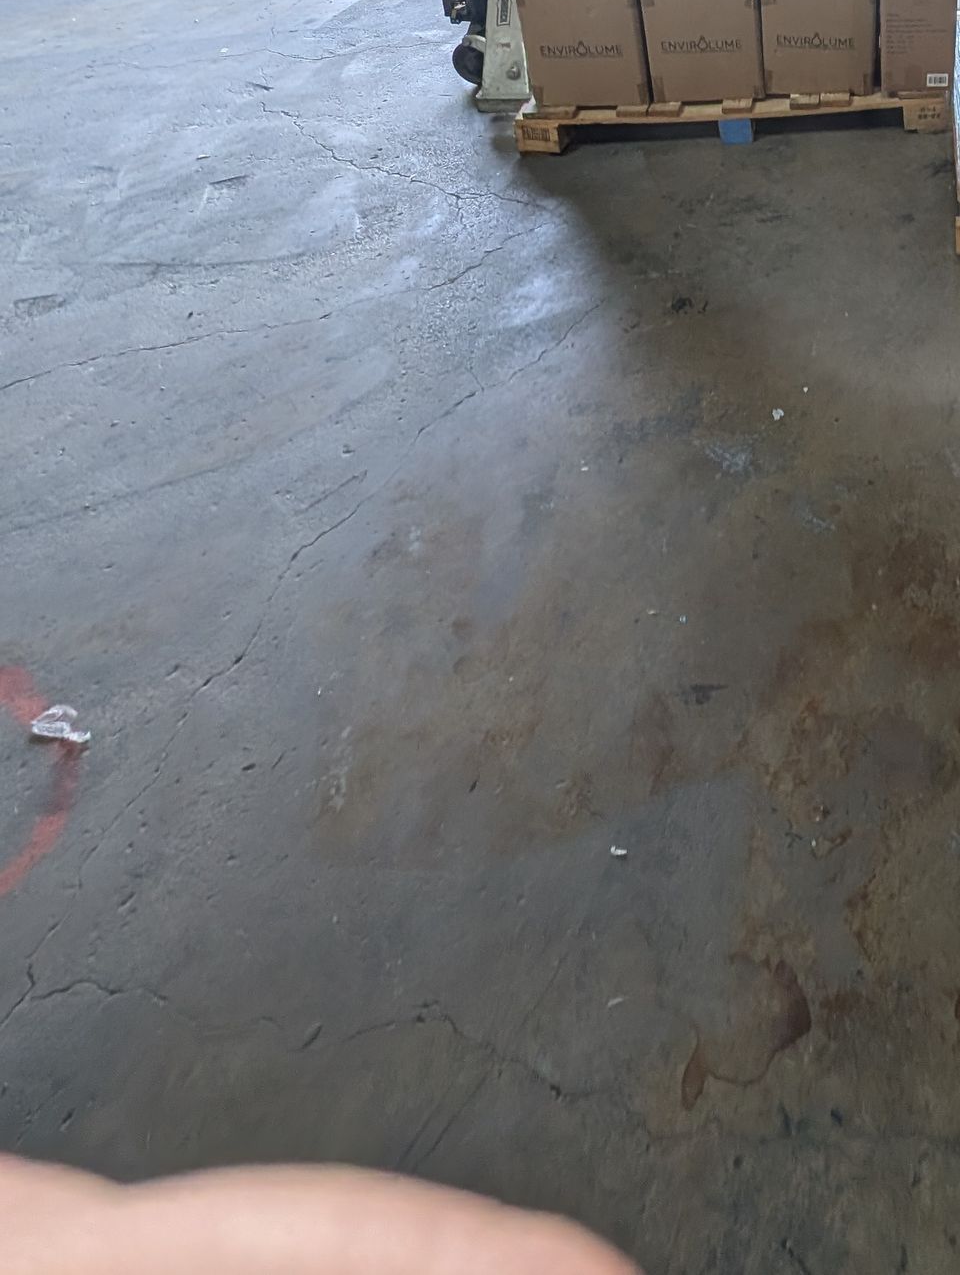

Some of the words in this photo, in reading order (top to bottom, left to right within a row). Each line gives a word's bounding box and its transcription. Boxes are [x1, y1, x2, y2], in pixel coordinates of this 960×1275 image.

[540, 40, 623, 58] ENVIROLUME
[660, 35, 743, 52] ENVIROLUME
[776, 31, 855, 49] ENVIROLUME
